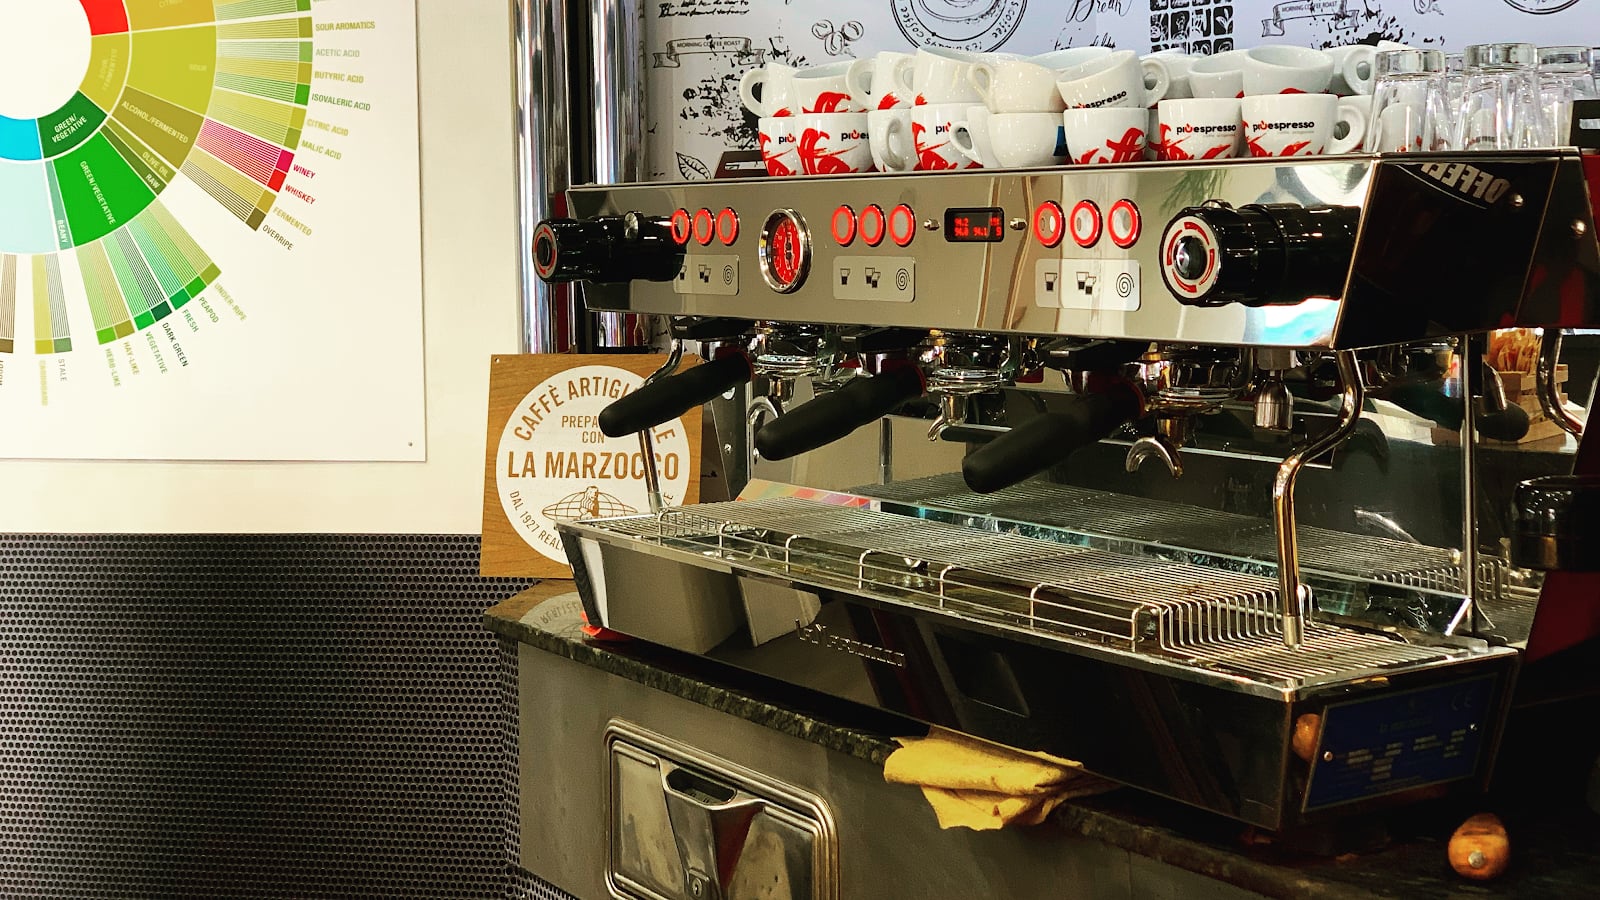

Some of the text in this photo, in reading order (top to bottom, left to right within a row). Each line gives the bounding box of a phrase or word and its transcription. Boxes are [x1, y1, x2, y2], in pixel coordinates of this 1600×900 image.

[315, 21, 376, 31] SOUR AROMATICS
[315, 48, 341, 57] ACETIC
[314, 71, 364, 83] BUTYRIC ACID
[311, 92, 371, 111] ISOVALERIC ACID
[52, 115, 87, 143] VEGETATIVE
[54, 113, 78, 133] GREEN/
[121, 100, 189, 144] ALCOHOL/FERMENTED
[307, 118, 349, 136] CITRIC ACID
[301, 140, 342, 160] MALIC ACID
[142, 151, 169, 177] OLIVE OIL
[293, 163, 316, 179] WINEY
[80, 161, 116, 225] GREEN/VEGETATIVE
[145, 174, 160, 189] RAW
[285, 184, 316, 205] WHISKEY
[57, 219, 69, 243] BEANY
[272, 206, 313, 237] FERMENTED
[262, 224, 294, 251] OVERRIPE
[198, 296, 219, 323] PEAPOD
[214, 283, 247, 321] UNDER-RIPE
[182, 309, 199, 332] FRESH
[146, 331, 168, 374] VEGETATIVE
[162, 322, 188, 367] DARK GREEN
[58, 358, 67, 382] STALE
[123, 341, 140, 375] HAY-LIKE
[514, 385, 564, 441] CAFFÈ
[561, 415, 599, 428] PREPA
[582, 431, 605, 443] CON
[507, 451, 679, 481] LA MARZOCO
[509, 490, 521, 511] DAL
[519, 511, 540, 533] 1927
